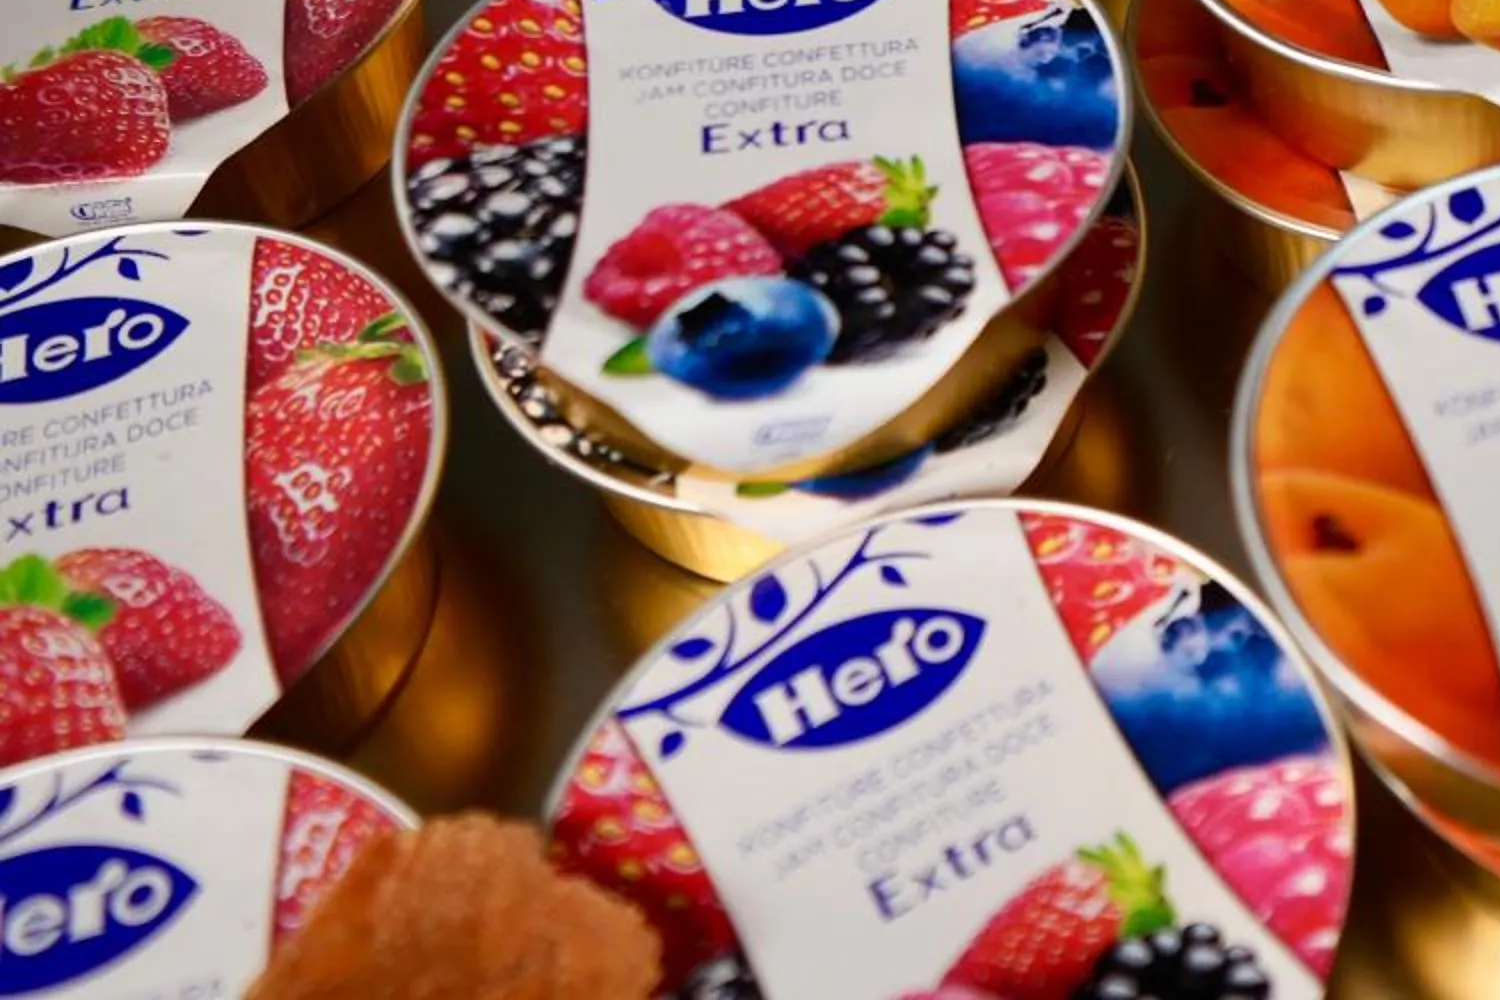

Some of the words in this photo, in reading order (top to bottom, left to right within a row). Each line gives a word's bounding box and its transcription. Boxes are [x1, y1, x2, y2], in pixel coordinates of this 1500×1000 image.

[619, 54, 754, 82] KONFITURE
[762, 37, 920, 67] CONFETTURA
[693, 68, 833, 98] CONFITURA
[841, 60, 908, 83] DOCE
[704, 88, 843, 120] CONFITURE
[701, 118, 851, 154] Extra
[43, 380, 213, 440] CONFETTURA
[0, 432, 117, 474] NFITURA
[127, 407, 199, 443] DOCE
[0, 453, 127, 500] ONFITURE
[7, 487, 129, 542] xtra
[753, 616, 965, 746] Hero
[867, 815, 1038, 923] Extra
[0, 857, 173, 956] ero
